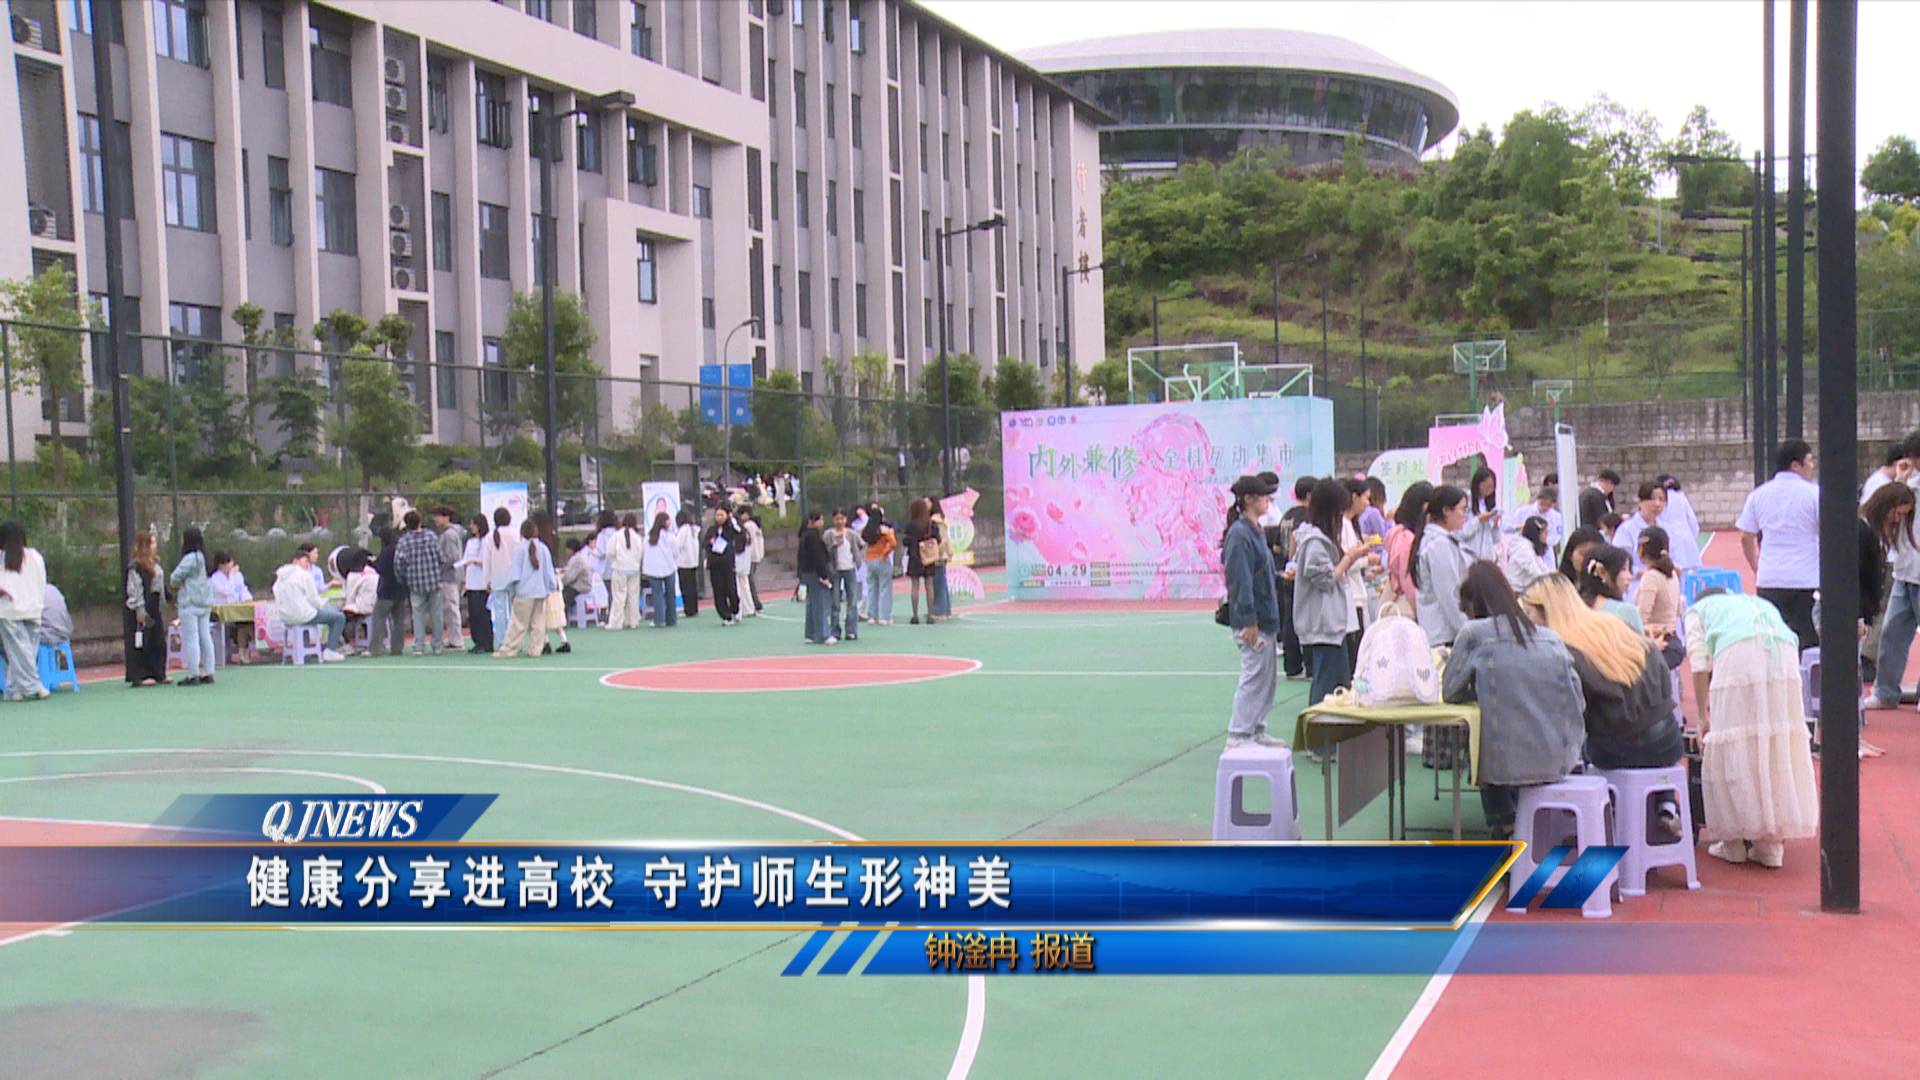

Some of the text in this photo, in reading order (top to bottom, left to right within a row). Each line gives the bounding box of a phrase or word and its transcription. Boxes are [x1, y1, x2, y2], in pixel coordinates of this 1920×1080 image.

[1028, 443, 1296, 478] 内外兼修 全科互动集市
[1047, 564, 1087, 577] 04.29
